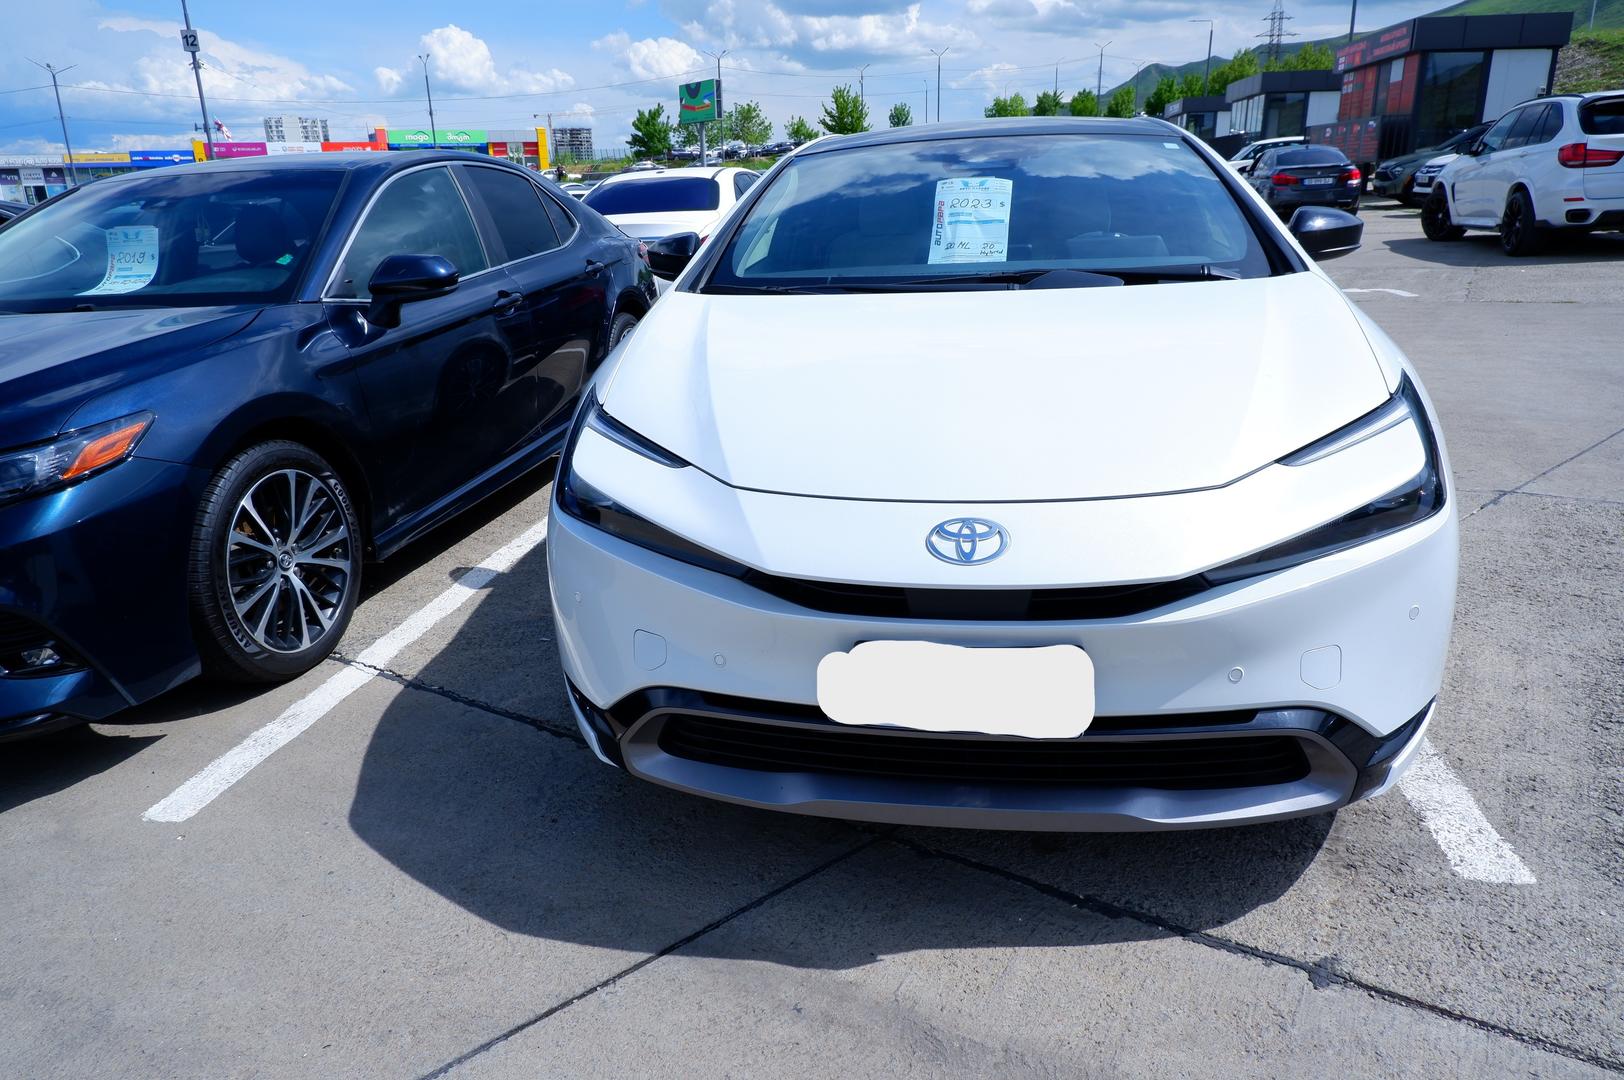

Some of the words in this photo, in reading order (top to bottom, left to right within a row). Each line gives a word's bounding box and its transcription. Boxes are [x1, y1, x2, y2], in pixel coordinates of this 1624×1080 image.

[183, 34, 198, 47] 12
[405, 133, 429, 142] mogo
[949, 198, 992, 209] 2023
[116, 251, 146, 264] 2019
